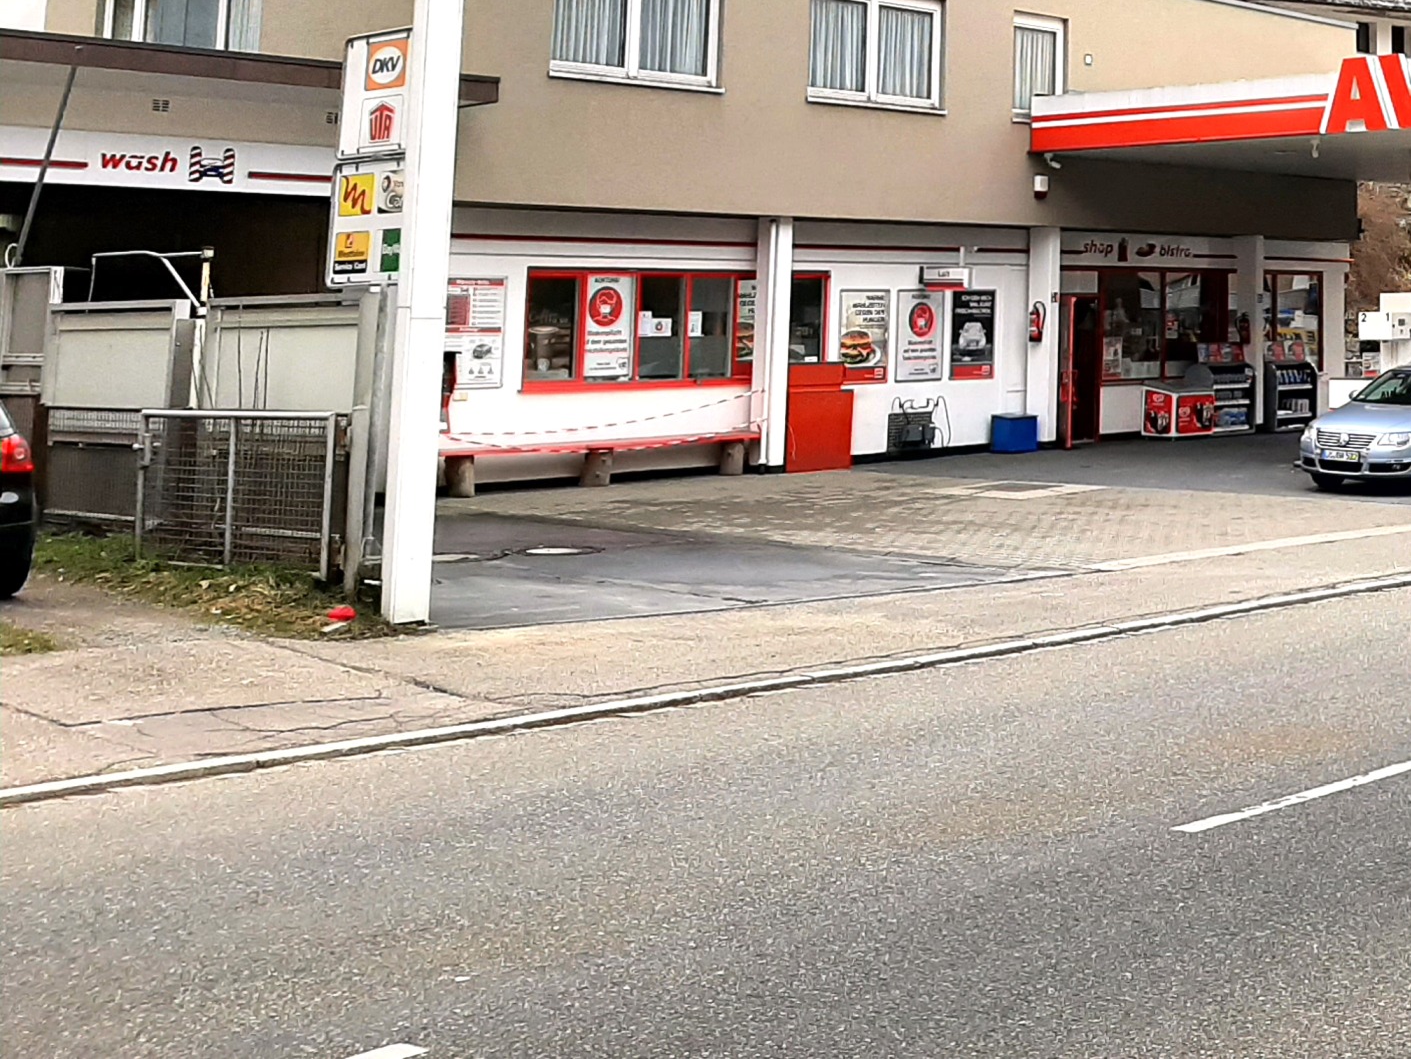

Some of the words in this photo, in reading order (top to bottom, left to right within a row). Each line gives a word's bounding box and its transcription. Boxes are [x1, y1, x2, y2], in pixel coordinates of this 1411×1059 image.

[371, 55, 401, 75] DKV
[369, 103, 396, 141] UTA
[101, 151, 178, 173] wash
[1083, 240, 1114, 258] shop
[1361, 312, 1367, 323] 2
[1386, 312, 1390, 322] 1
